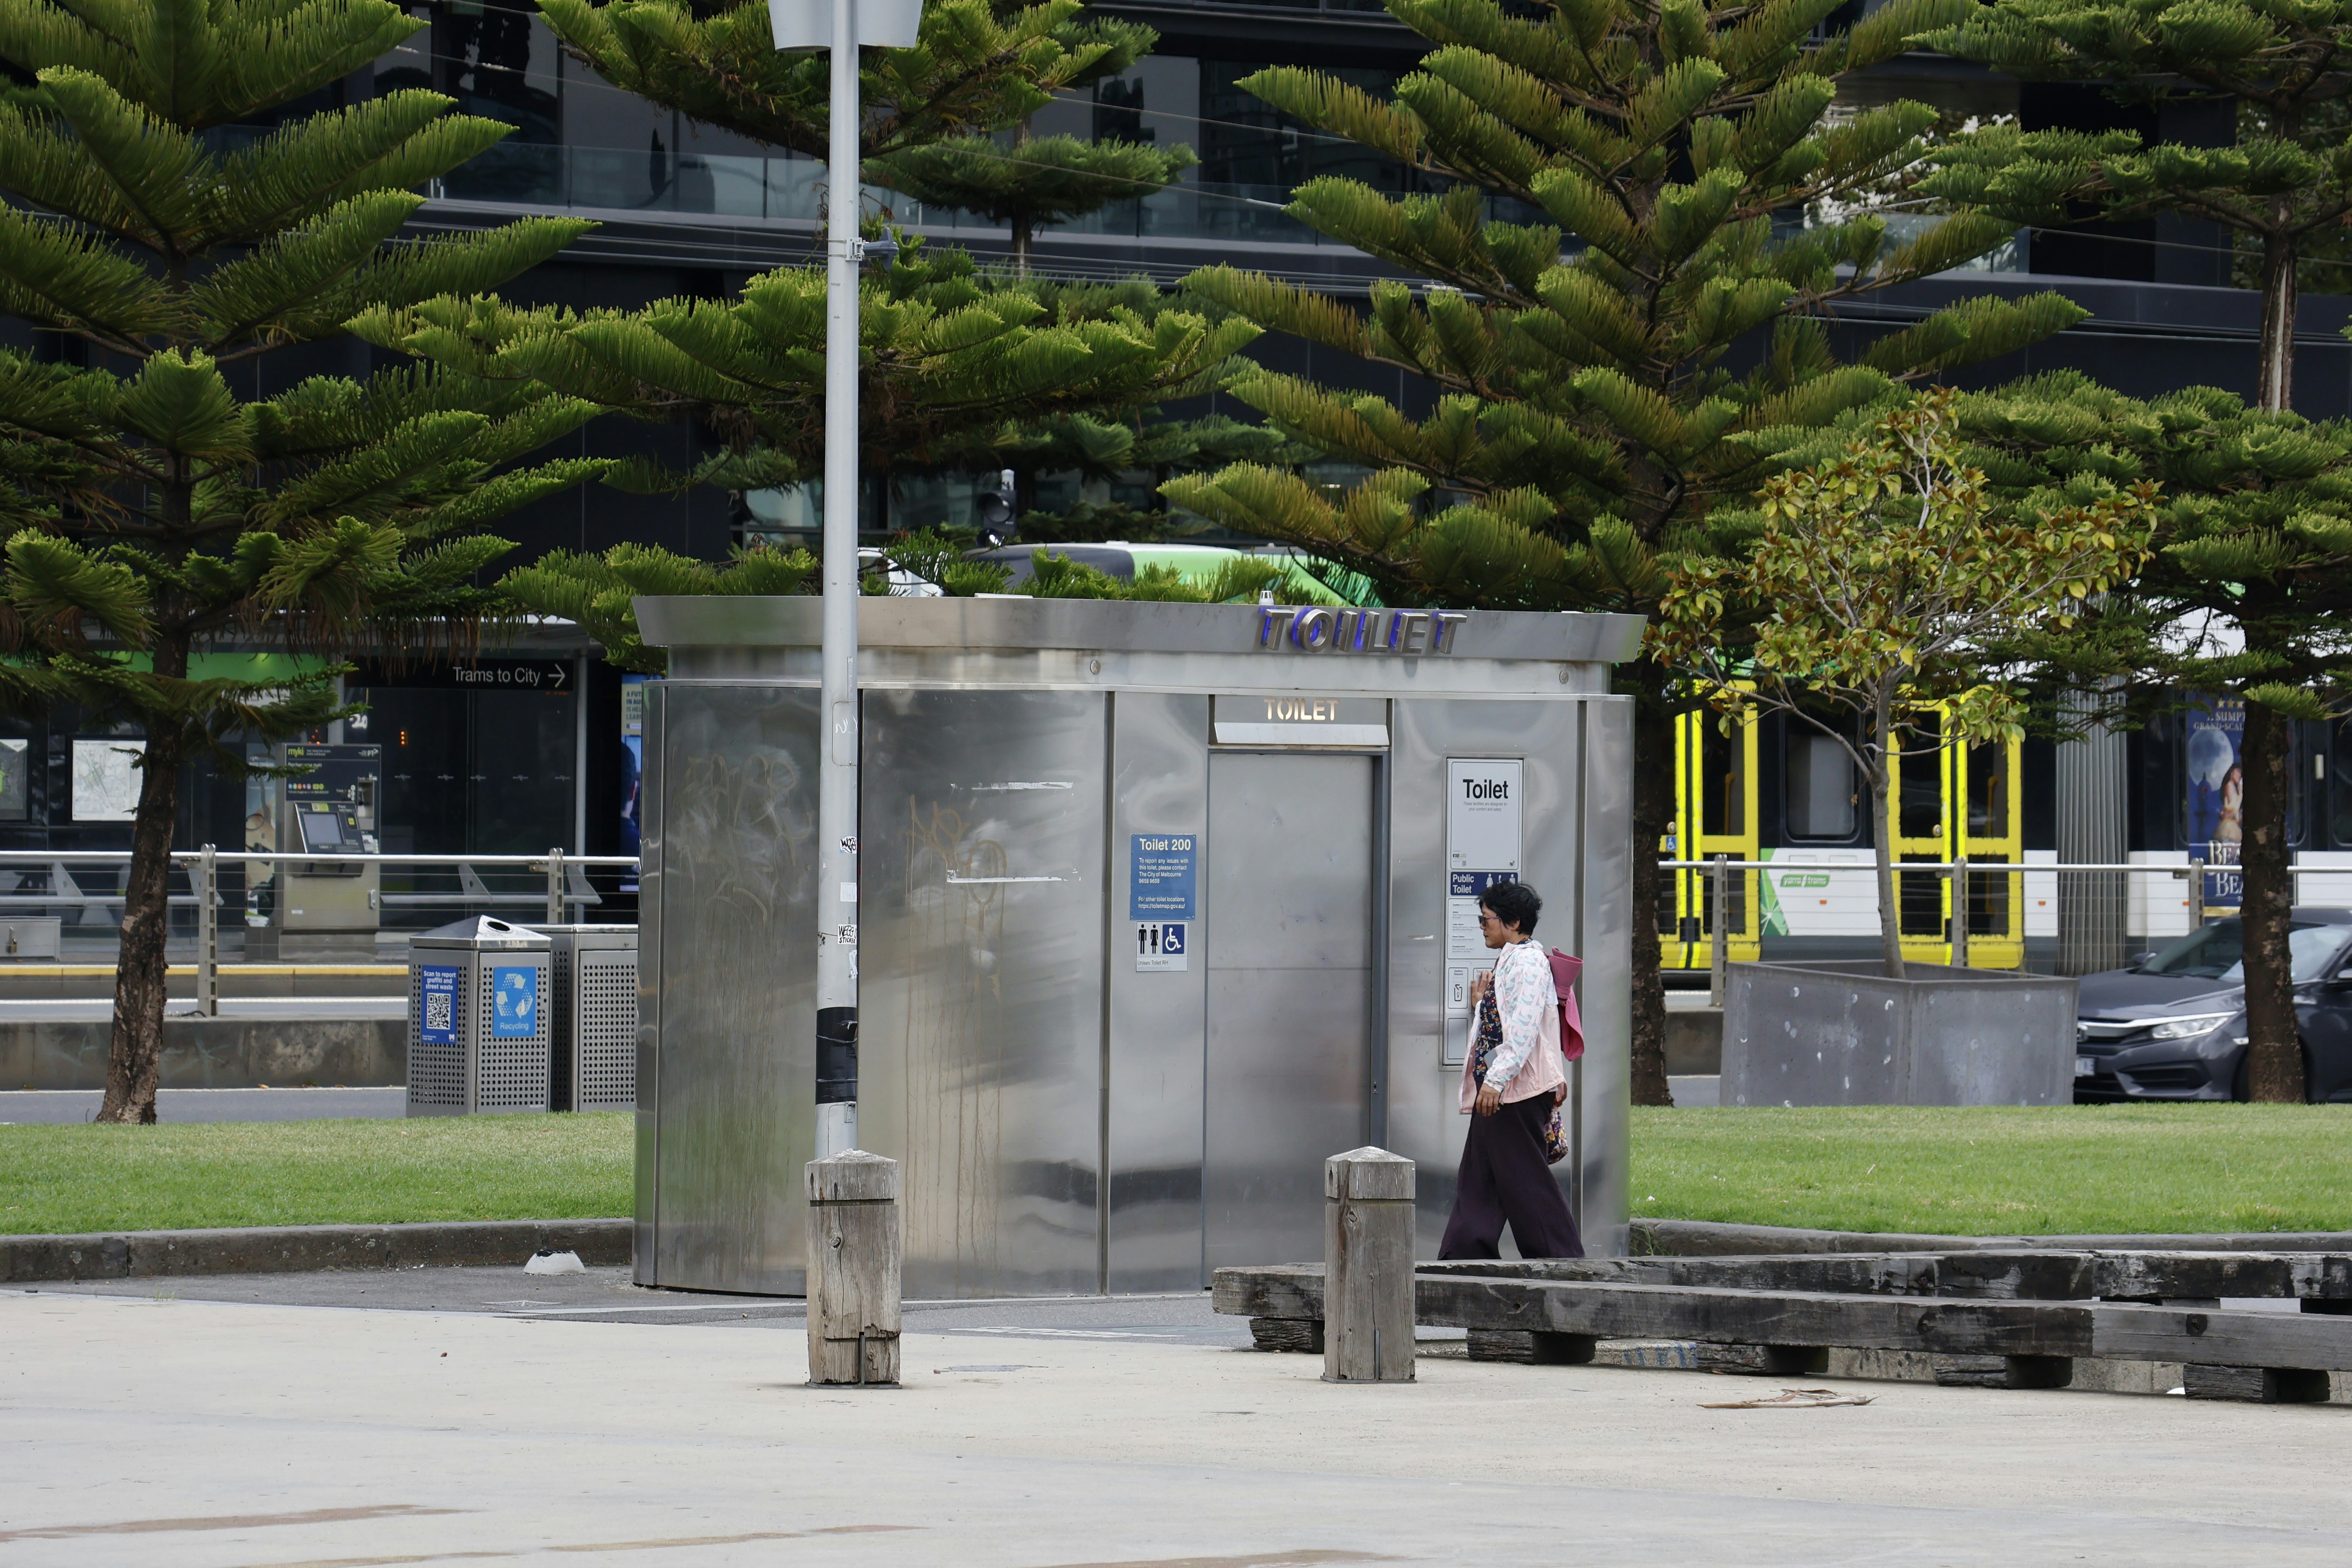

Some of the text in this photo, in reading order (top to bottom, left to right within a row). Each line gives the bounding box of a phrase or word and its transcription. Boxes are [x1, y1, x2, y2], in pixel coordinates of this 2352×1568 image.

[1265, 608, 1467, 654] TOILET
[453, 666, 540, 687] Trams to City
[1263, 698, 1340, 721] TOILET
[288, 747, 304, 757] myki
[1463, 779, 1508, 799] Toilet
[1140, 838, 1191, 851] Toilet 200
[1453, 874, 1474, 883] Public
[1784, 876, 1826, 886] yarra trams
[1452, 885, 1472, 893] Toilet
[500, 1022, 529, 1031] Recycling
